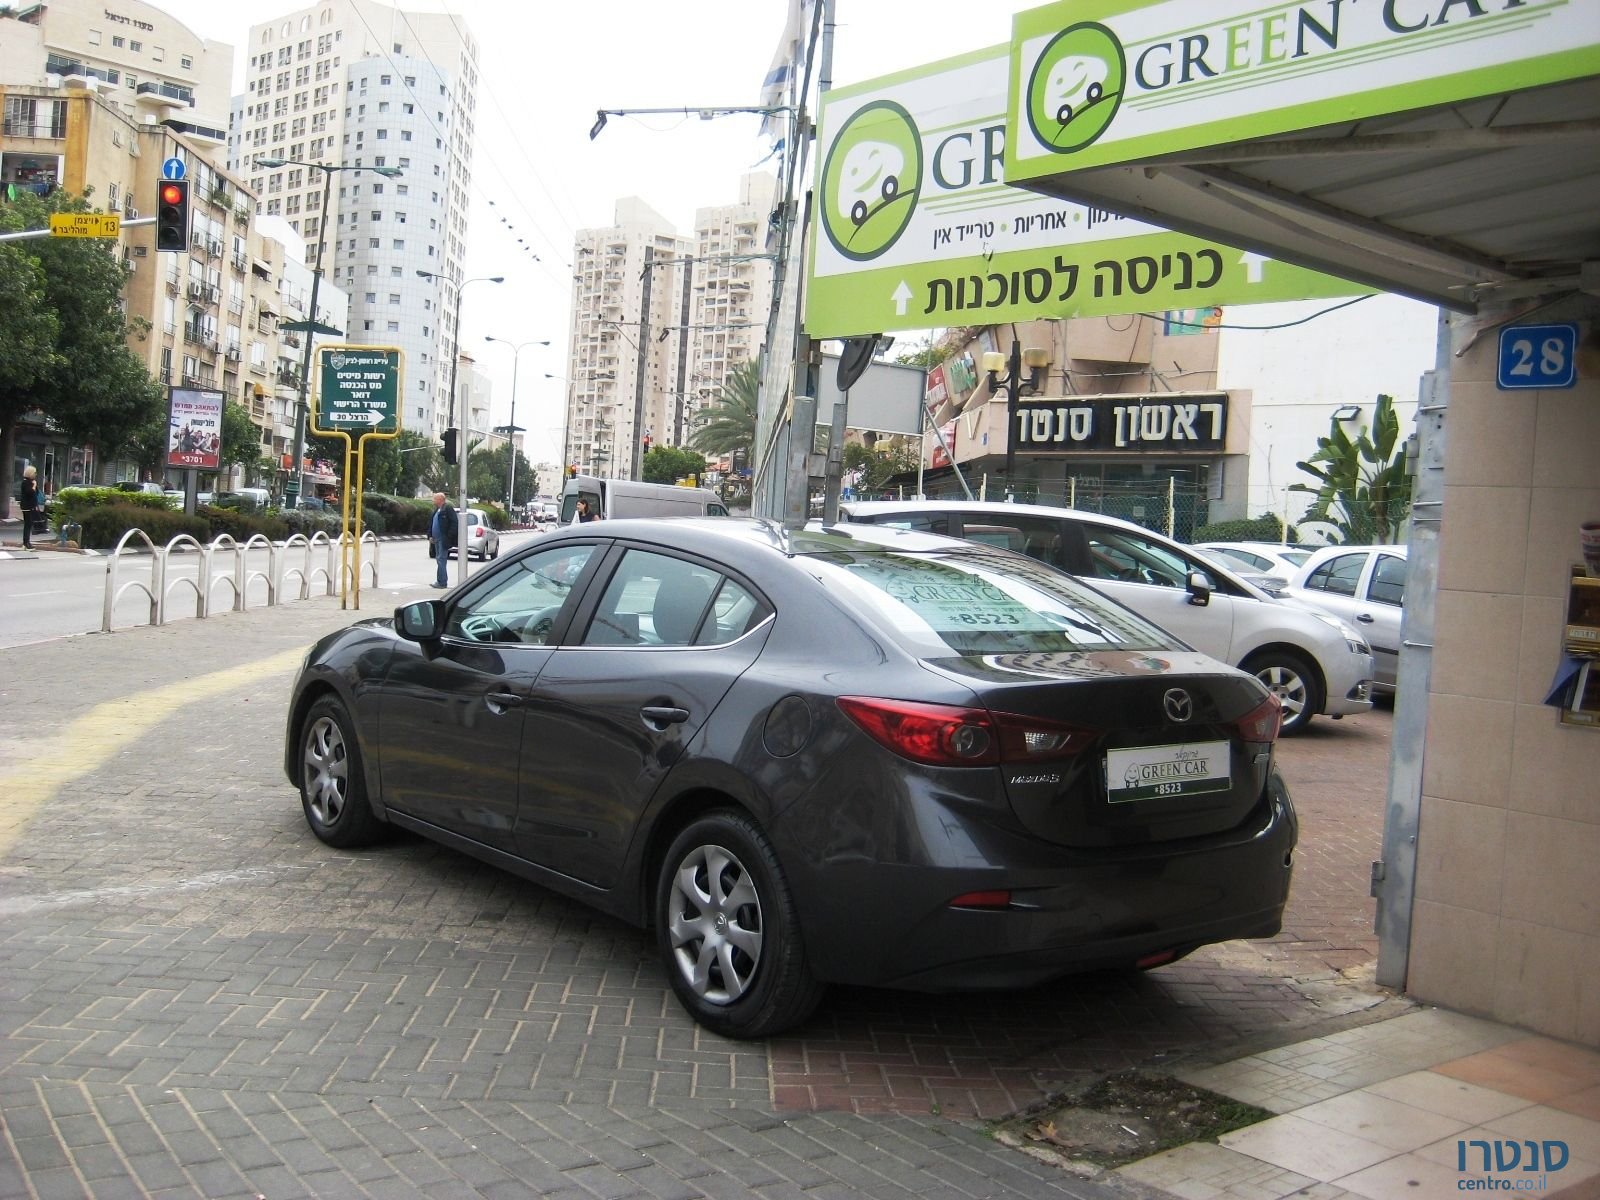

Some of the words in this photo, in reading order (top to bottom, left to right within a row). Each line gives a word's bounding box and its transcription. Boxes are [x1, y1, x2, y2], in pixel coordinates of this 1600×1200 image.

[1134, 0, 1344, 91] GREEN
[59, 226, 88, 234] מוהליבר
[74, 217, 94, 226] ויצמן
[104, 221, 116, 232] 13
[956, 220, 995, 242] טרייד
[1013, 210, 1067, 235] אחריות
[933, 226, 951, 249] אין
[924, 255, 1080, 314] לסוכנות
[1093, 248, 1223, 298] כניסה
[1509, 338, 1565, 377] 28
[1114, 403, 1223, 447] ראשון
[912, 584, 979, 601] GREEN
[1141, 761, 1181, 779] GREEN
[1184, 759, 1208, 775] CAR
